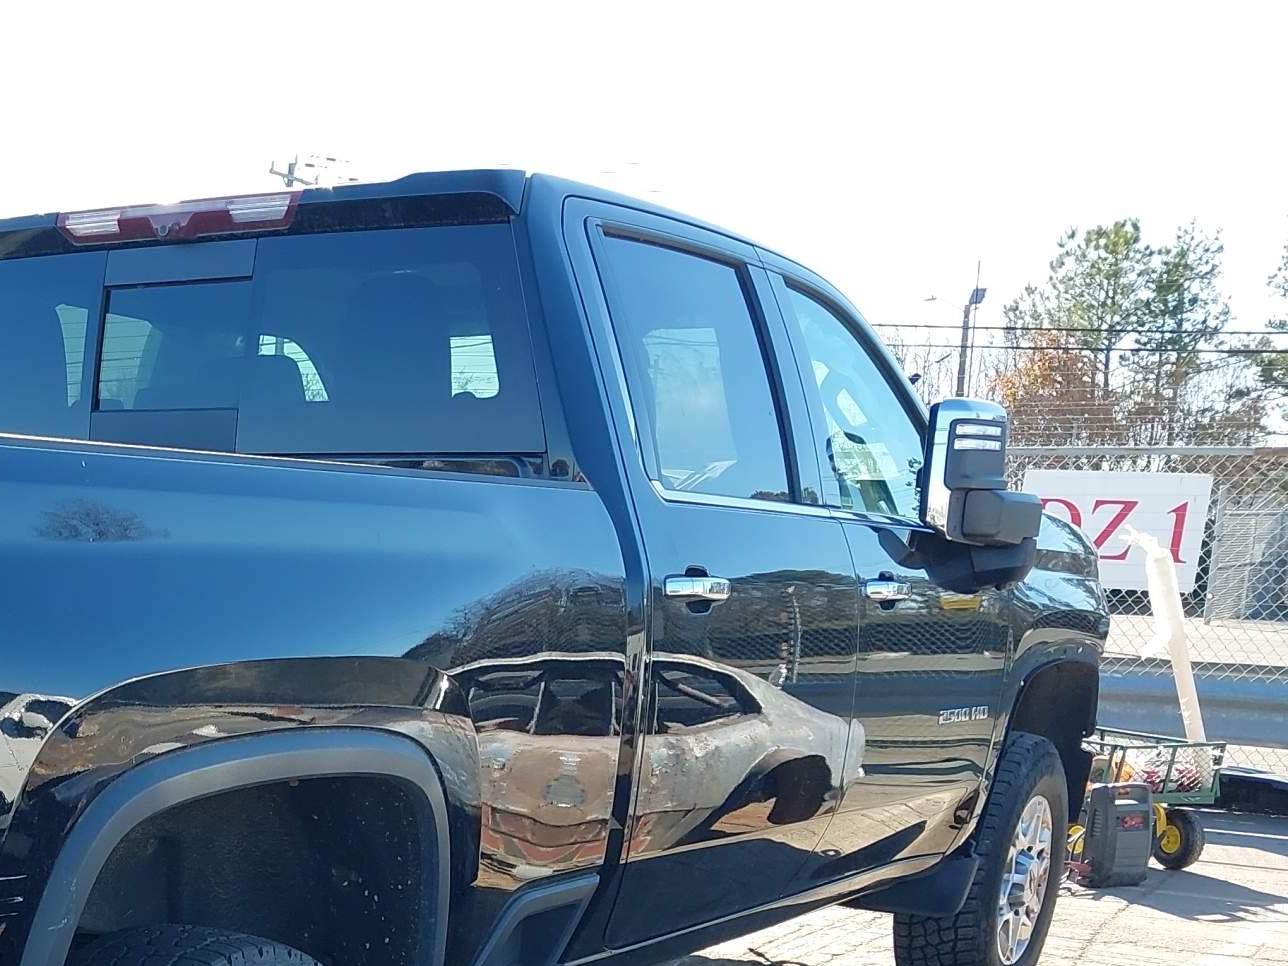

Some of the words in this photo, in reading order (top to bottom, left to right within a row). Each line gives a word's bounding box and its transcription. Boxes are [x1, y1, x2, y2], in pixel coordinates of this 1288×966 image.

[1167, 501, 1189, 564] 1
[938, 707, 970, 725] 2500
[971, 705, 989, 721] HD
